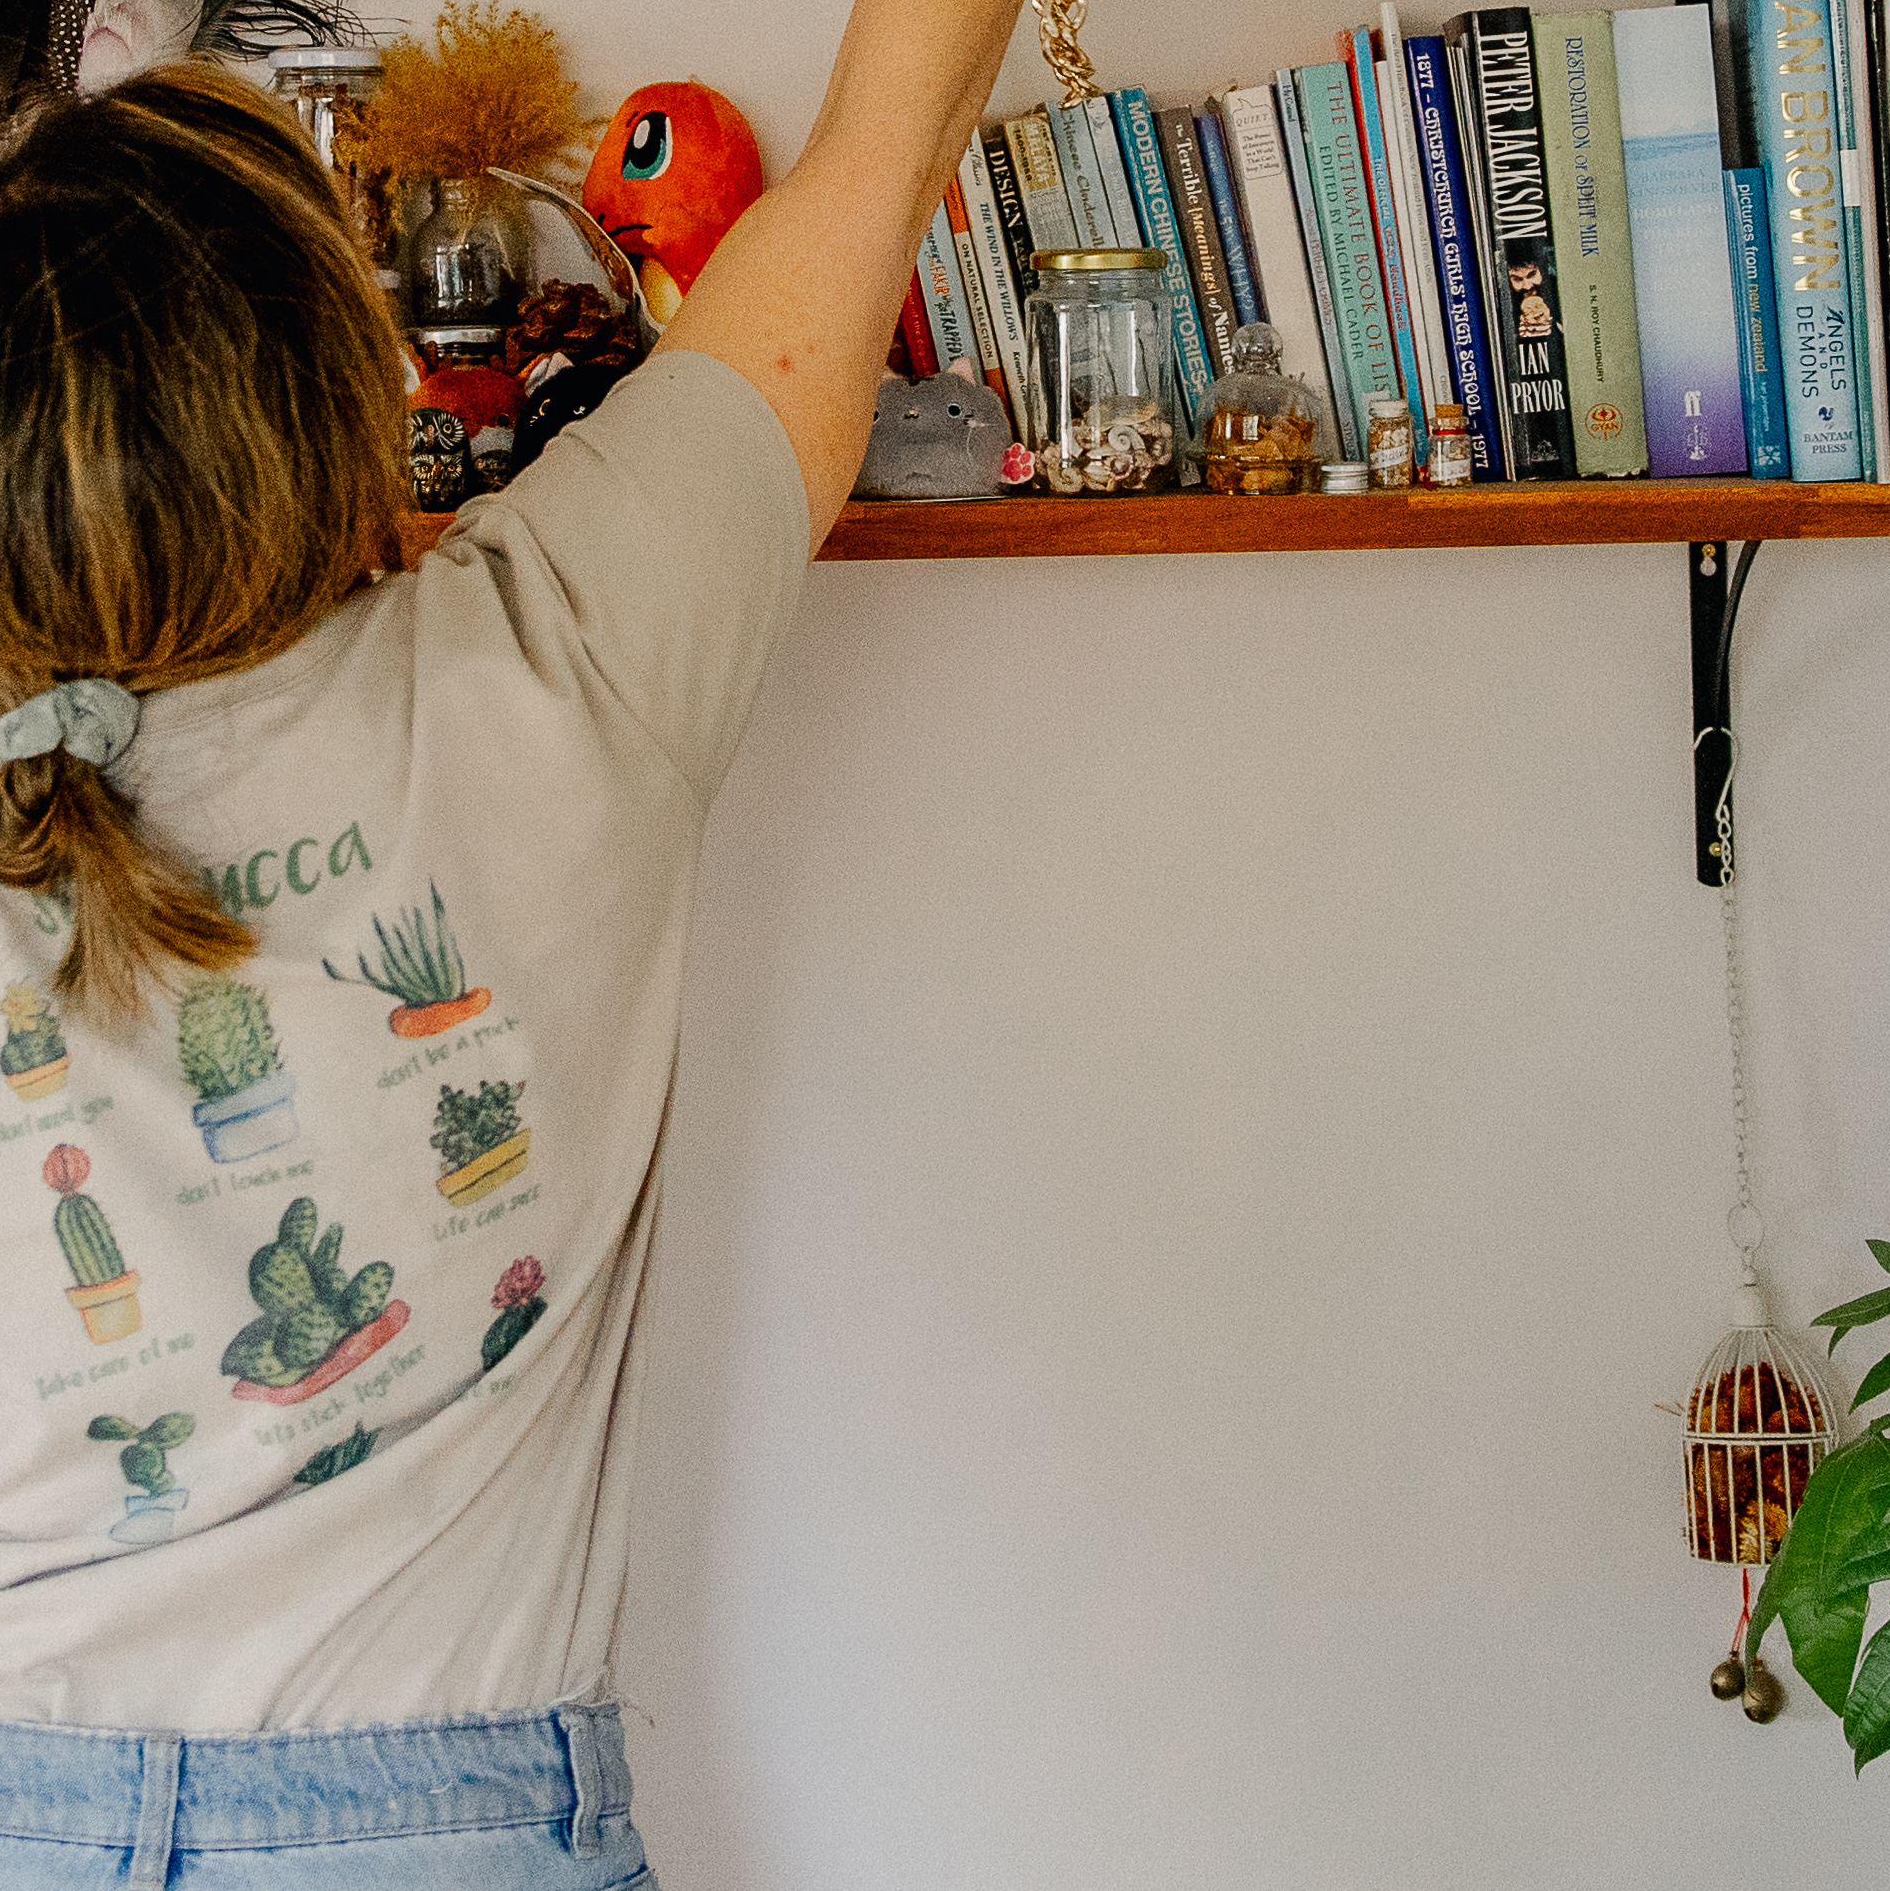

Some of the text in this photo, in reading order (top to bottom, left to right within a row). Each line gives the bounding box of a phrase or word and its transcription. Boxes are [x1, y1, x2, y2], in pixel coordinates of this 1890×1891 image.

[1415, 51, 1434, 90] 1877
[1236, 114, 1269, 127] QUIET
[1476, 29, 1548, 243] PETER JACKSON
[1561, 34, 1600, 259] RESTORATION SPLIT MILK
[1021, 120, 1054, 184] MALAYA
[1422, 105, 1457, 239] CHRISTCHURCH
[978, 203, 992, 227] THE
[988, 148, 1023, 229] DESIGN
[1736, 183, 1757, 242] pictures
[1777, 87, 1843, 292] BROWN
[983, 225, 999, 256] WIND
[1325, 80, 1386, 353] THE ULTIMATE BOOK OF
[989, 255, 1003, 271] IN
[1125, 100, 1209, 387] MODERN CHINESE STORIES
[1172, 136, 1243, 377] Terrible of Names
[1317, 144, 1365, 360] EDITED BY MICHAEL CADER
[1743, 244, 1761, 279] from
[960, 243, 994, 360] ON NATURAL SELECTION
[992, 270, 1007, 291] THE
[1747, 282, 1762, 312] new
[938, 308, 963, 356] TRAPPED
[996, 291, 1019, 344] WILLOWS
[1450, 301, 1474, 348] HIGH
[1586, 284, 1605, 384] S. N. ROY CHAUDHURY
[1010, 350, 1027, 384] Kenneth
[1518, 340, 1551, 376] IAN
[1750, 316, 1768, 373] zealand
[1785, 304, 1830, 399] DEMONS
[1812, 330, 1832, 370] AND
[1816, 303, 1858, 393] ANGELS
[1456, 348, 1482, 418] SCHOOL
[1512, 377, 1567, 415] PRYOR
[1468, 433, 1490, 472] 1977
[1803, 431, 1853, 443] BANTAM
[1812, 443, 1848, 455] PRESS
